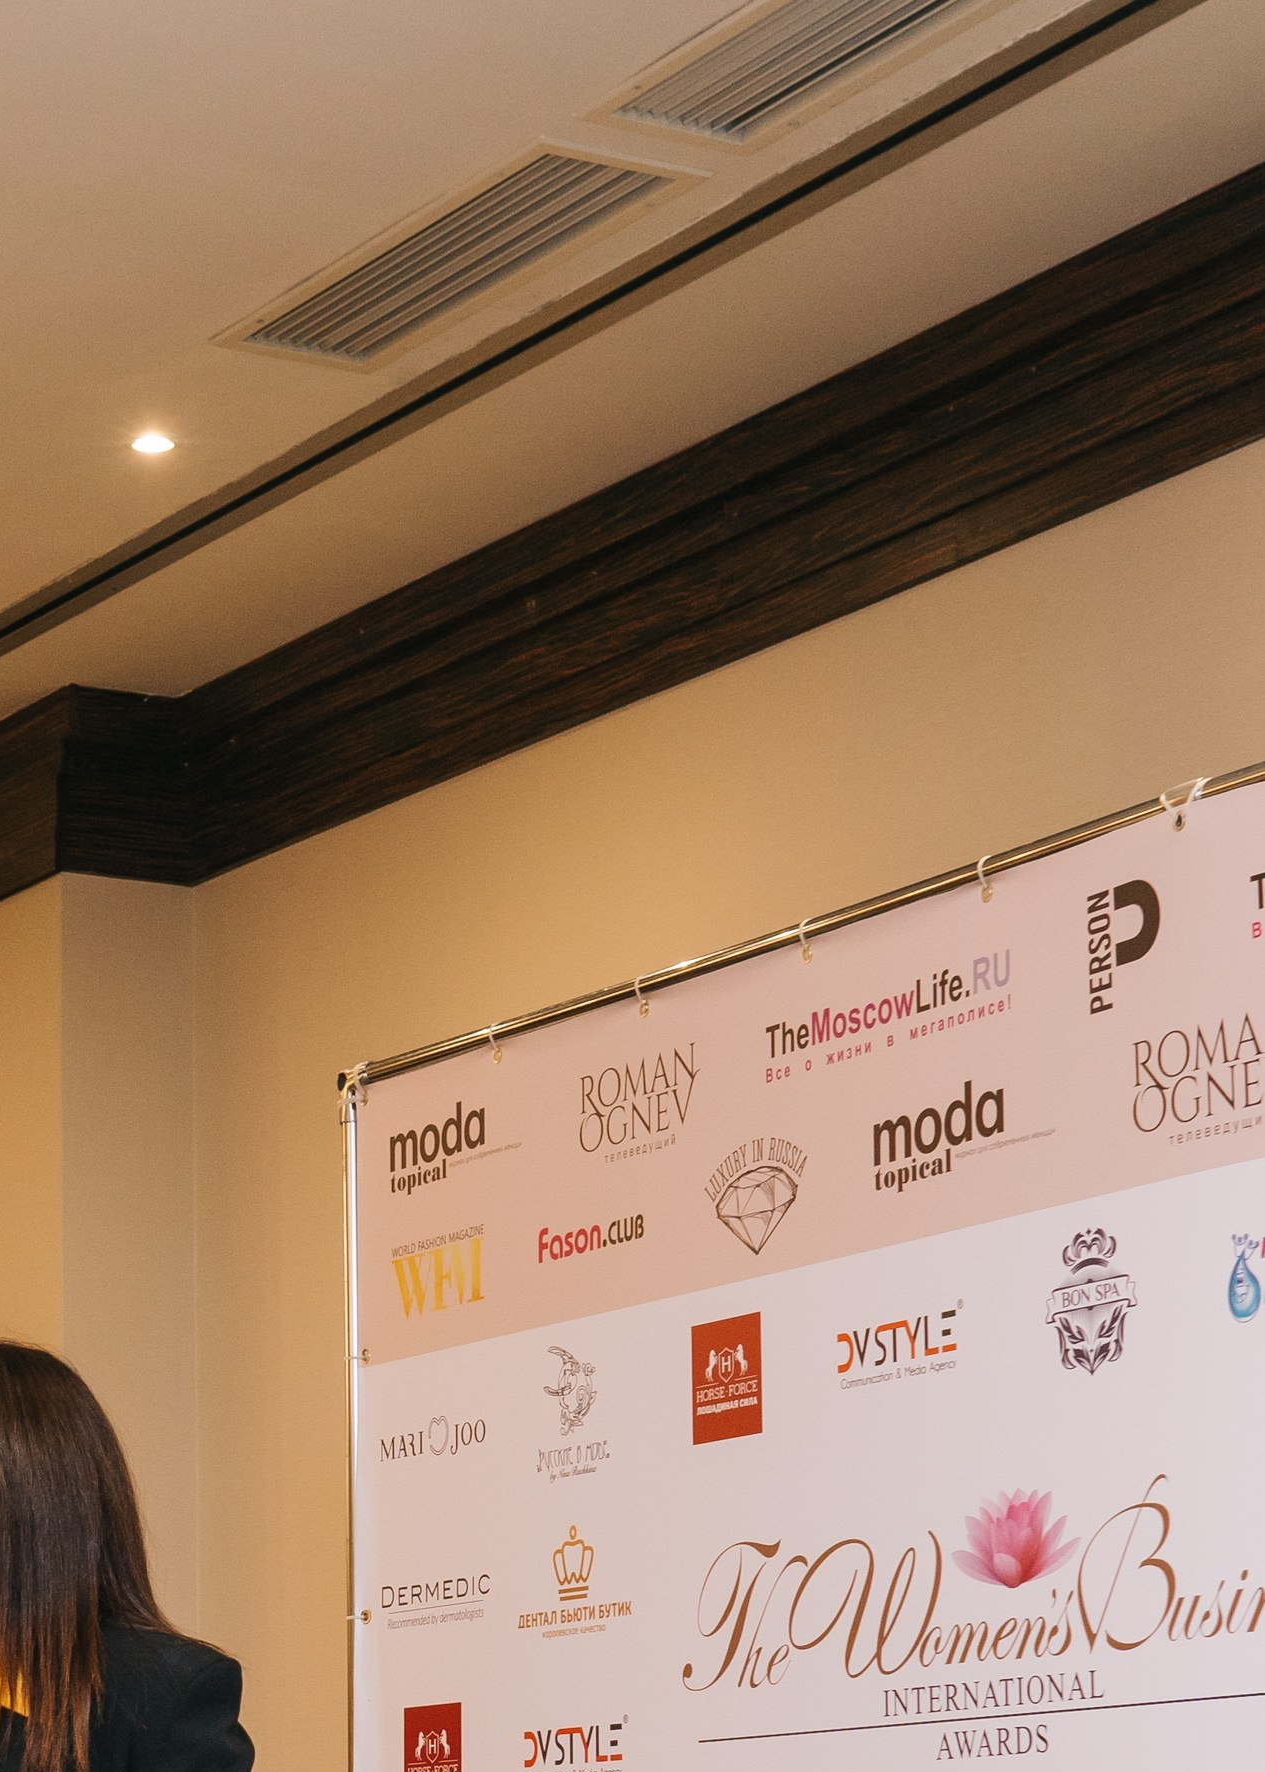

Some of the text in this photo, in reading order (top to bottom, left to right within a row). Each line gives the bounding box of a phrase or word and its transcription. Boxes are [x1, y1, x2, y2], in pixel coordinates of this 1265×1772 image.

[1087, 889, 1114, 1015] PERSON
[765, 949, 1011, 1058] TheMoscowLife.RU
[765, 994, 1012, 1083] Все о жизни в мегаполисе!
[580, 1042, 701, 1117] ROMAN
[389, 1102, 486, 1173] moda
[579, 1083, 694, 1153] OGNEV
[873, 1081, 1004, 1166] moda
[604, 1134, 677, 1164] телеведущий
[703, 1137, 808, 1203] LUXURY IN RUSSIA
[874, 1148, 952, 1192] topical
[390, 1158, 447, 1195] topical
[391, 1224, 484, 1258] WORLD FASHION MAGAZINE
[538, 1214, 645, 1264] Fason.CLUB
[1062, 1282, 1120, 1308] BON SPA
[904, 1364, 926, 1376] Media
[380, 1419, 486, 1462] MARI JOO
[382, 1574, 491, 1608] DERMEDIC
[518, 1601, 632, 1629] ДЕНТАЛ БЬЮТИ БУТИК
[682, 1538, 810, 1693] The
[884, 1669, 1105, 1718] INTERNATIONAL
[937, 1724, 1049, 1762] AWARDS
